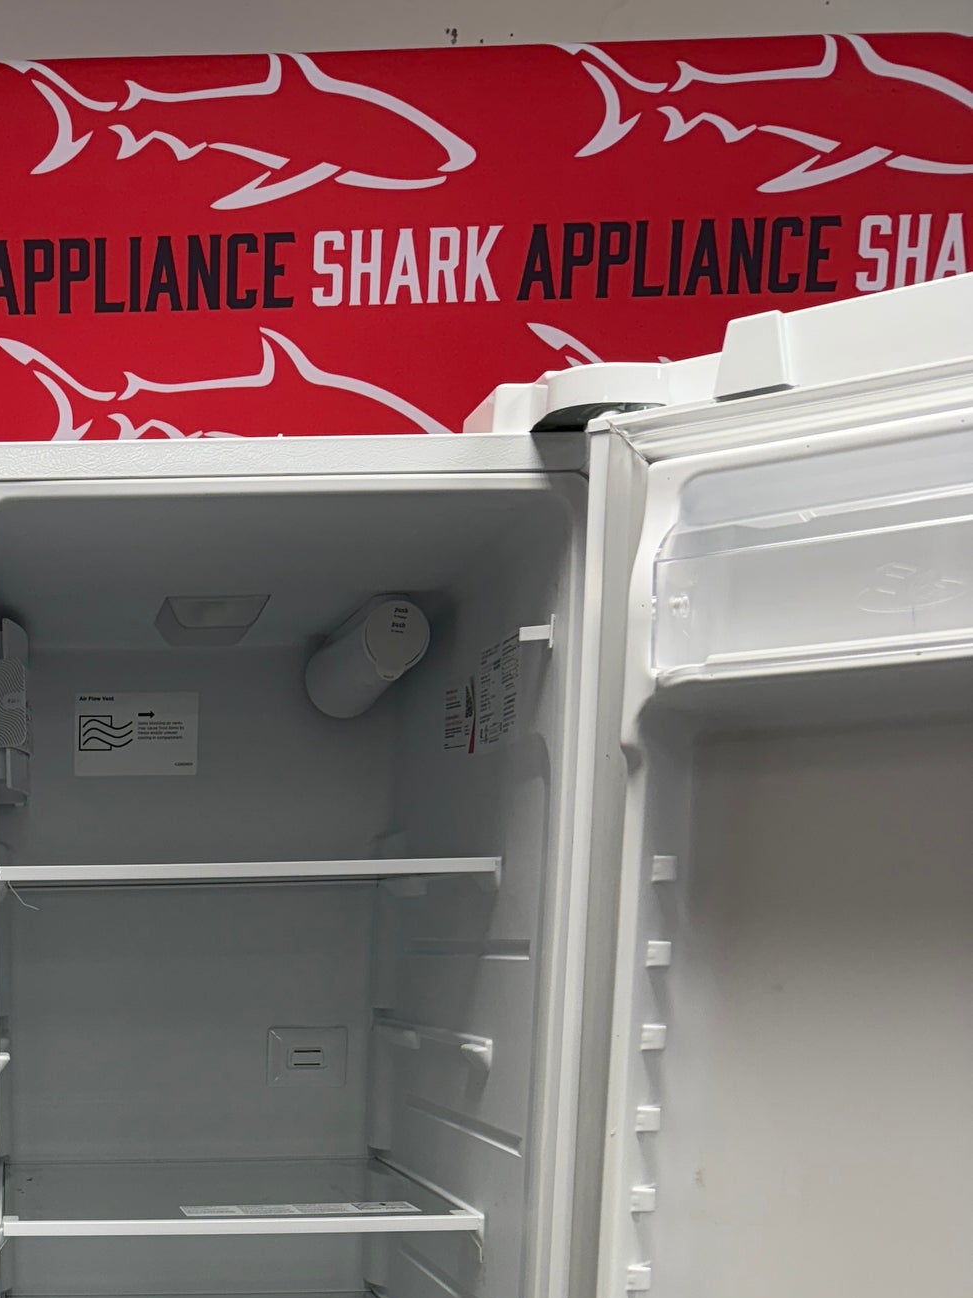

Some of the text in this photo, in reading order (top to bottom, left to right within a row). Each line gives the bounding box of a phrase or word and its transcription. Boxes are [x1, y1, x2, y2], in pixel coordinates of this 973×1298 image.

[310, 224, 504, 307] SHARK
[517, 215, 842, 301] APPLIANCE
[855, 213, 967, 291] SHA
